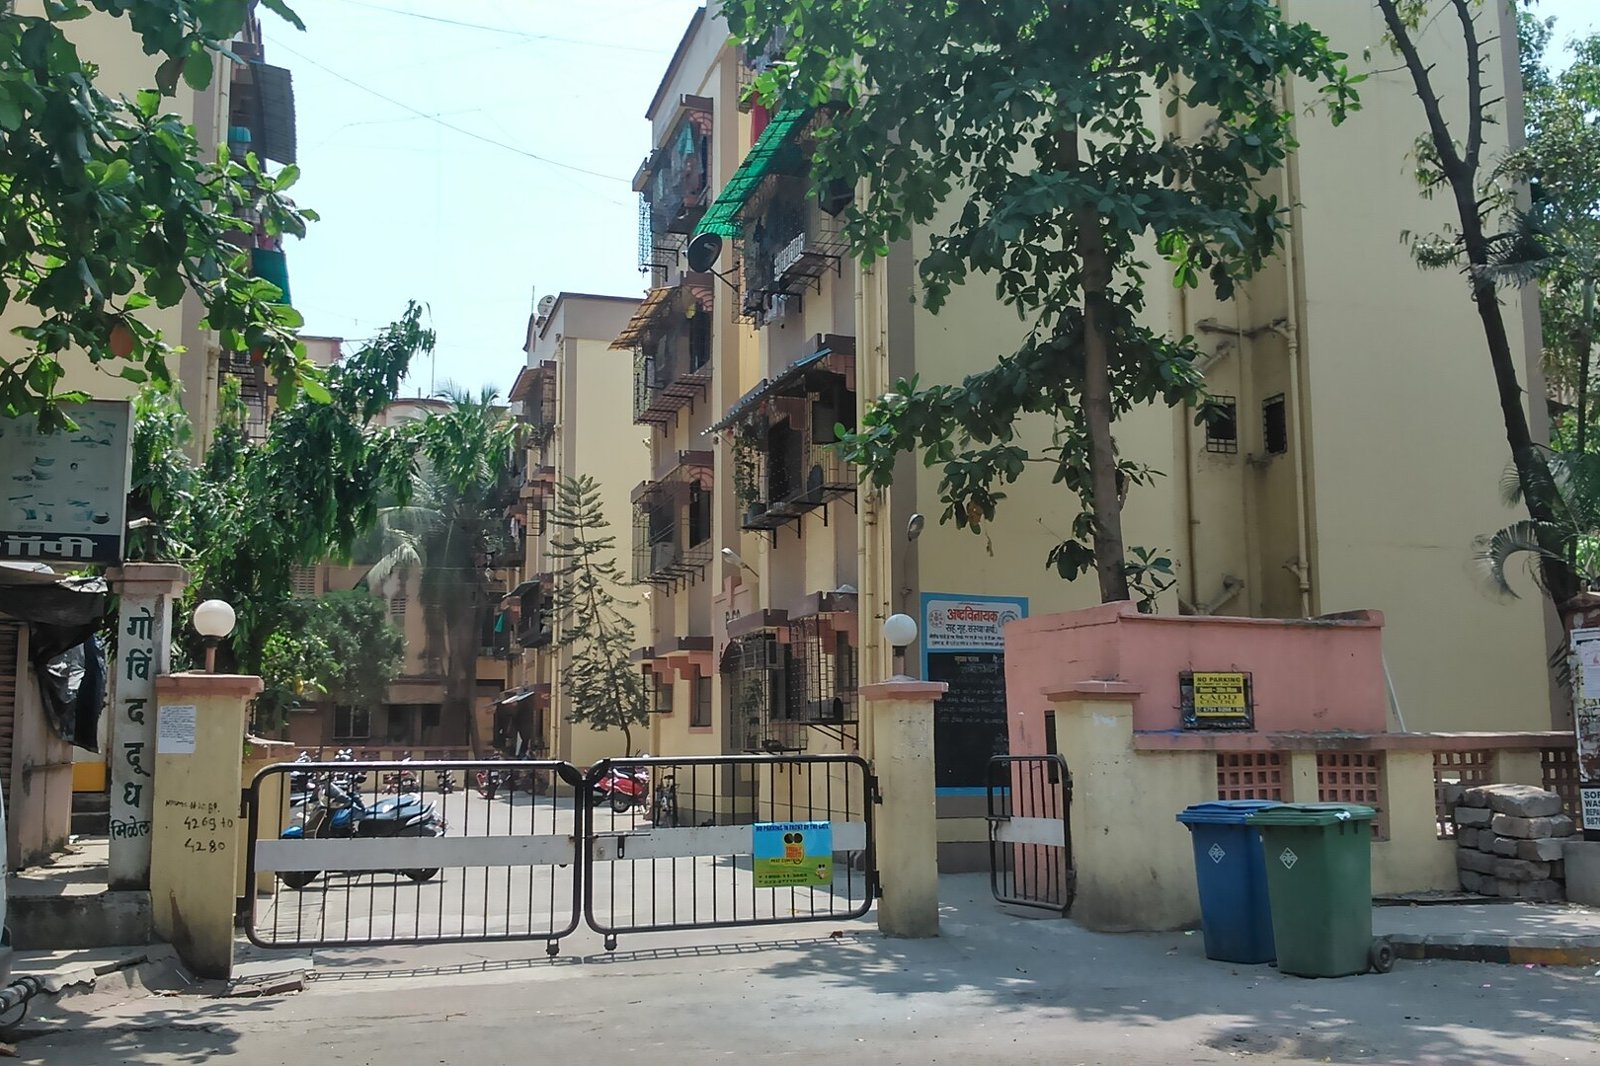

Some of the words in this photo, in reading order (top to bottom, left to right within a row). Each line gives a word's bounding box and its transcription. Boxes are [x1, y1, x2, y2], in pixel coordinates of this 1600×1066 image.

[947, 606, 999, 623] अष्टविनायक
[110, 815, 151, 840] मिळेल
[184, 838, 226, 853] 4280
